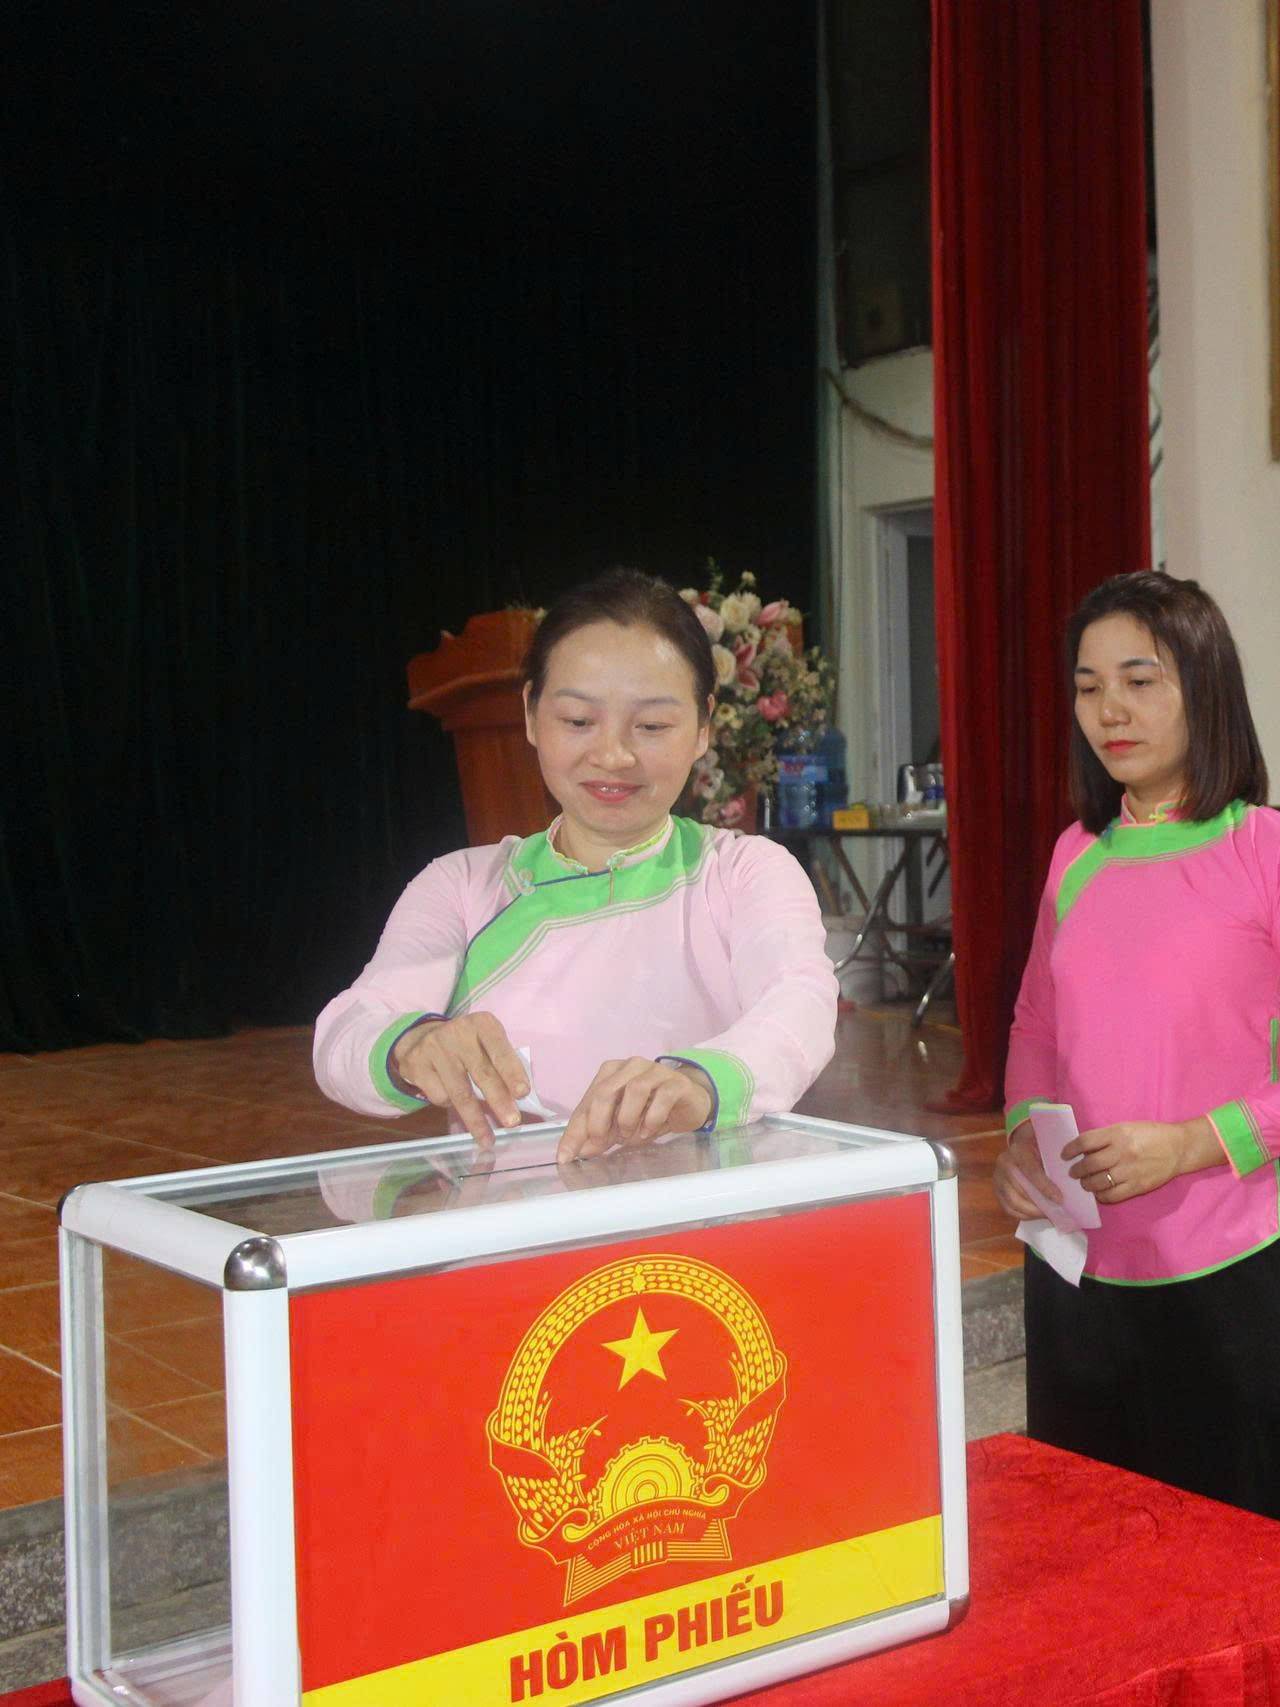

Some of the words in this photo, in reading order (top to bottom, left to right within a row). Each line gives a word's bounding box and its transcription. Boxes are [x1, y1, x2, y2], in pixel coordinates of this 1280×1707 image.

[614, 1526, 649, 1549] VIỆT
[653, 1522, 685, 1536] NAM
[510, 1625, 627, 1703] HÒM
[644, 1574, 784, 1662] PHIẾU
